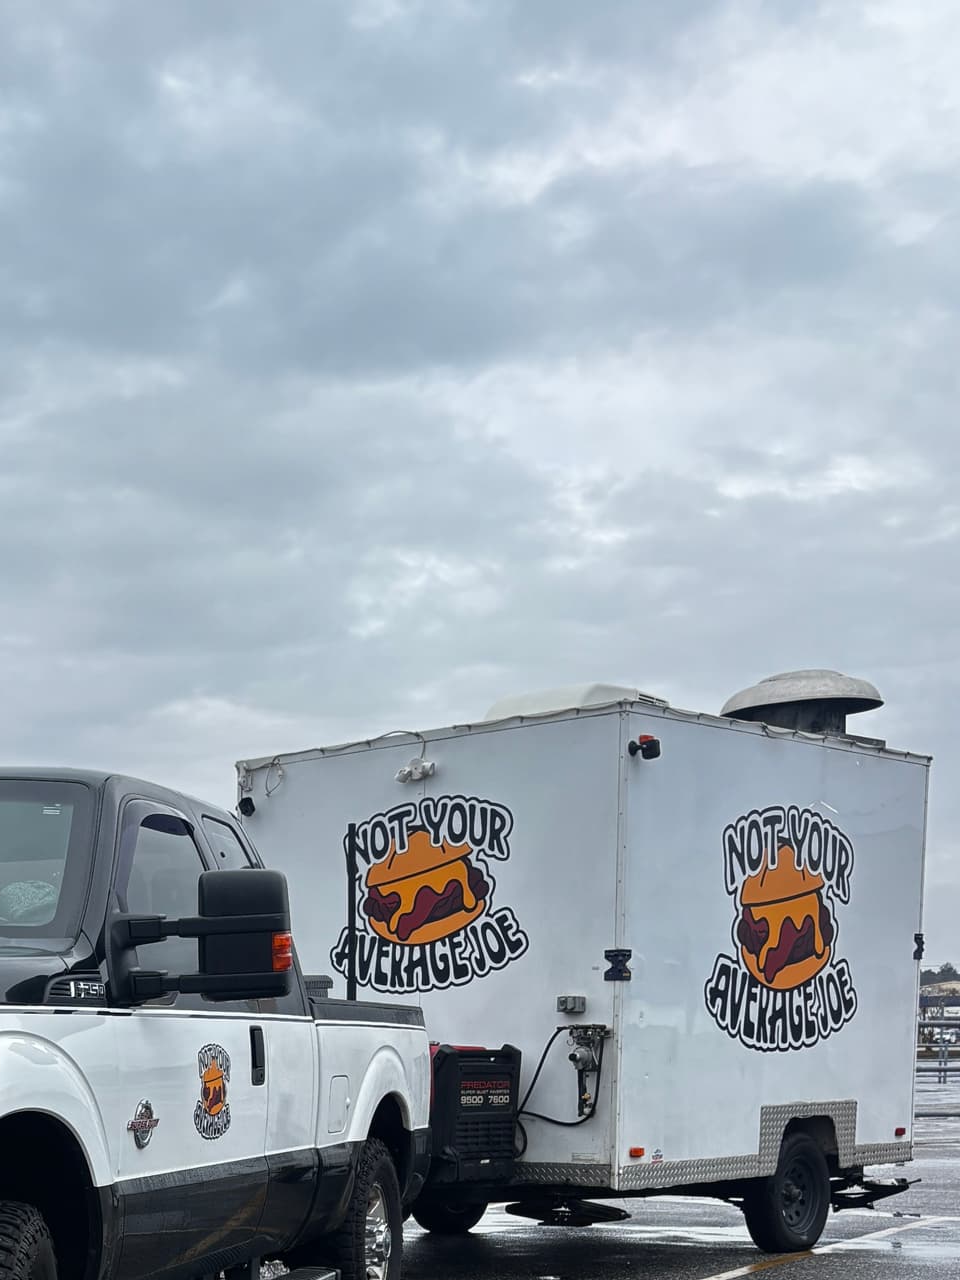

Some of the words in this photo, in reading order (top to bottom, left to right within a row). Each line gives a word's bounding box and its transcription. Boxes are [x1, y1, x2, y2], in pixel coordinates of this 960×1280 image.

[348, 808, 413, 868] NOT
[423, 801, 507, 857] YOUR
[726, 814, 783, 887] NOT
[790, 809, 851, 899] YOUR
[334, 931, 470, 989] AVERAGE
[471, 914, 524, 973] JOE
[708, 963, 816, 1045] AVERAGE
[816, 966, 856, 1033] JOE
[460, 1080, 510, 1089] PREDATOR
[460, 1095, 484, 1104] 9500
